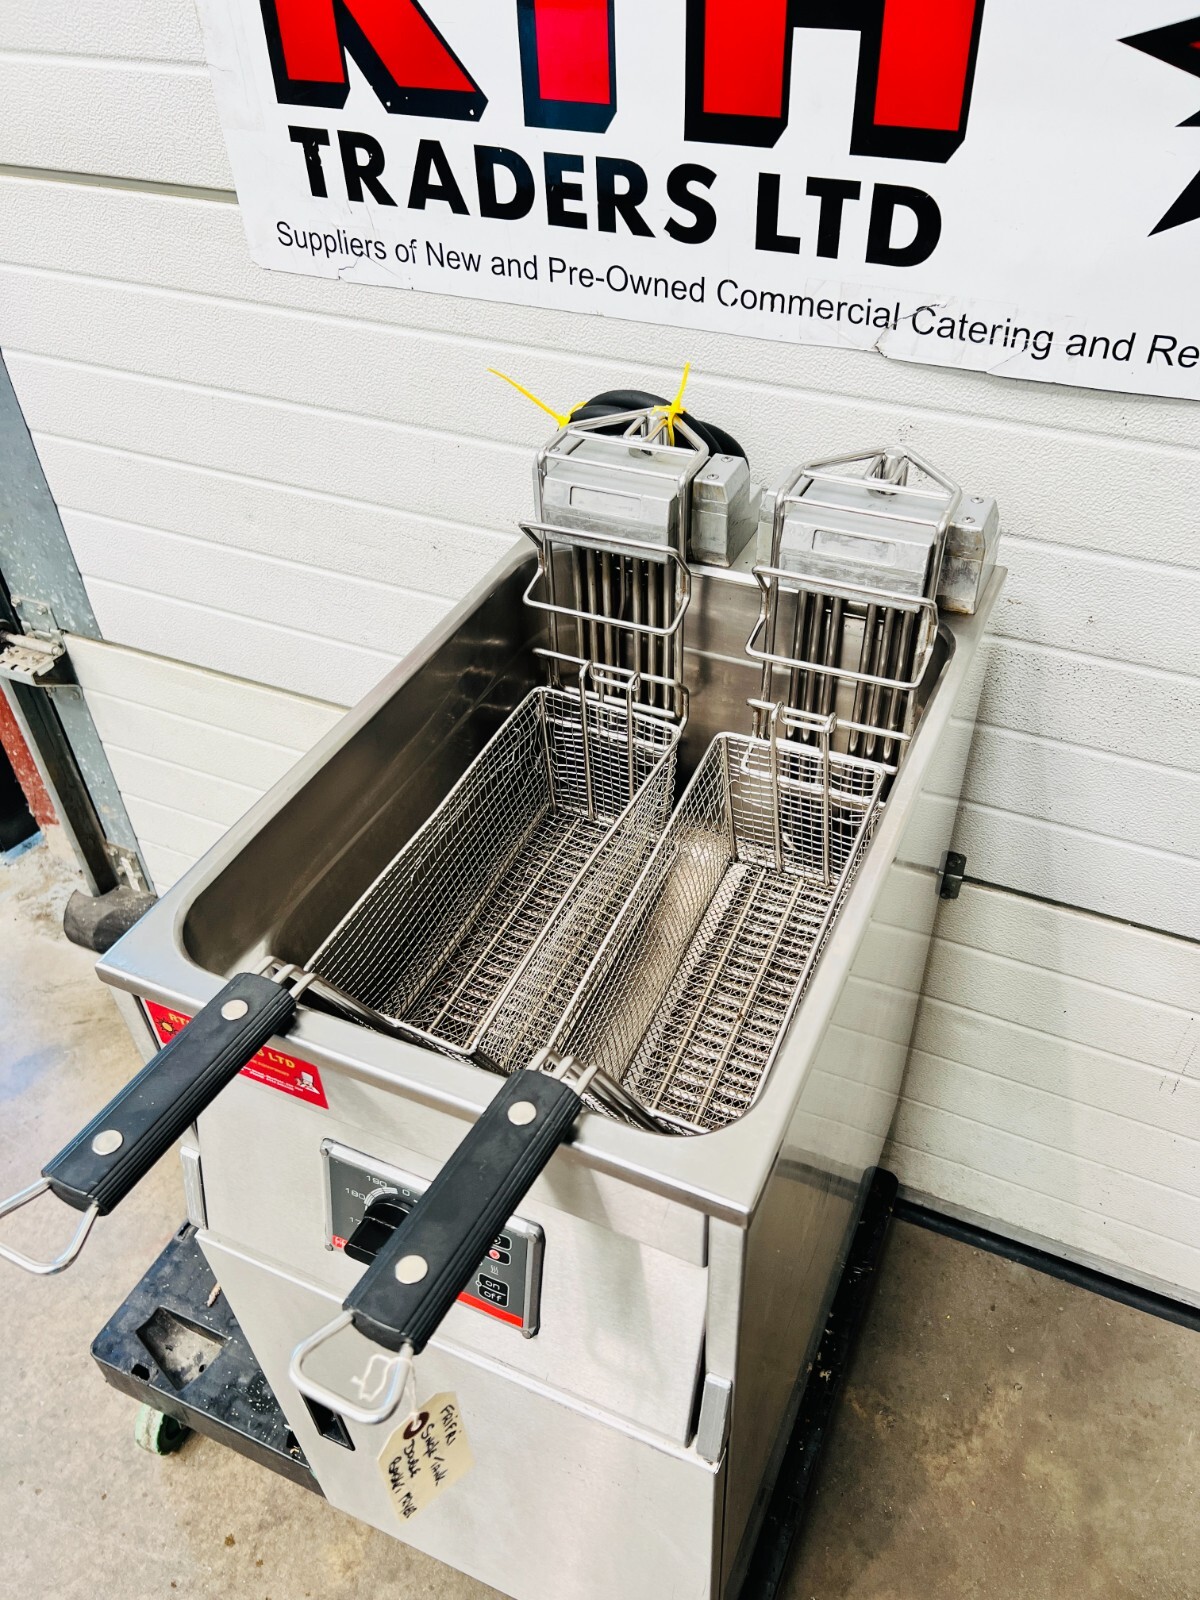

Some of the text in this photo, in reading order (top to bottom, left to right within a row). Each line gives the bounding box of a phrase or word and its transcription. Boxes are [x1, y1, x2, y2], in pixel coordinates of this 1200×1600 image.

[287, 125, 942, 268] TRADERS LTD
[276, 221, 1200, 369] Suppliers of New and Pre-Owned Commercial Catering and Re
[267, 1051, 296, 1069] LTD
[349, 1216, 362, 1226] 17
[485, 1280, 500, 1291] on
[483, 1290, 502, 1302] off
